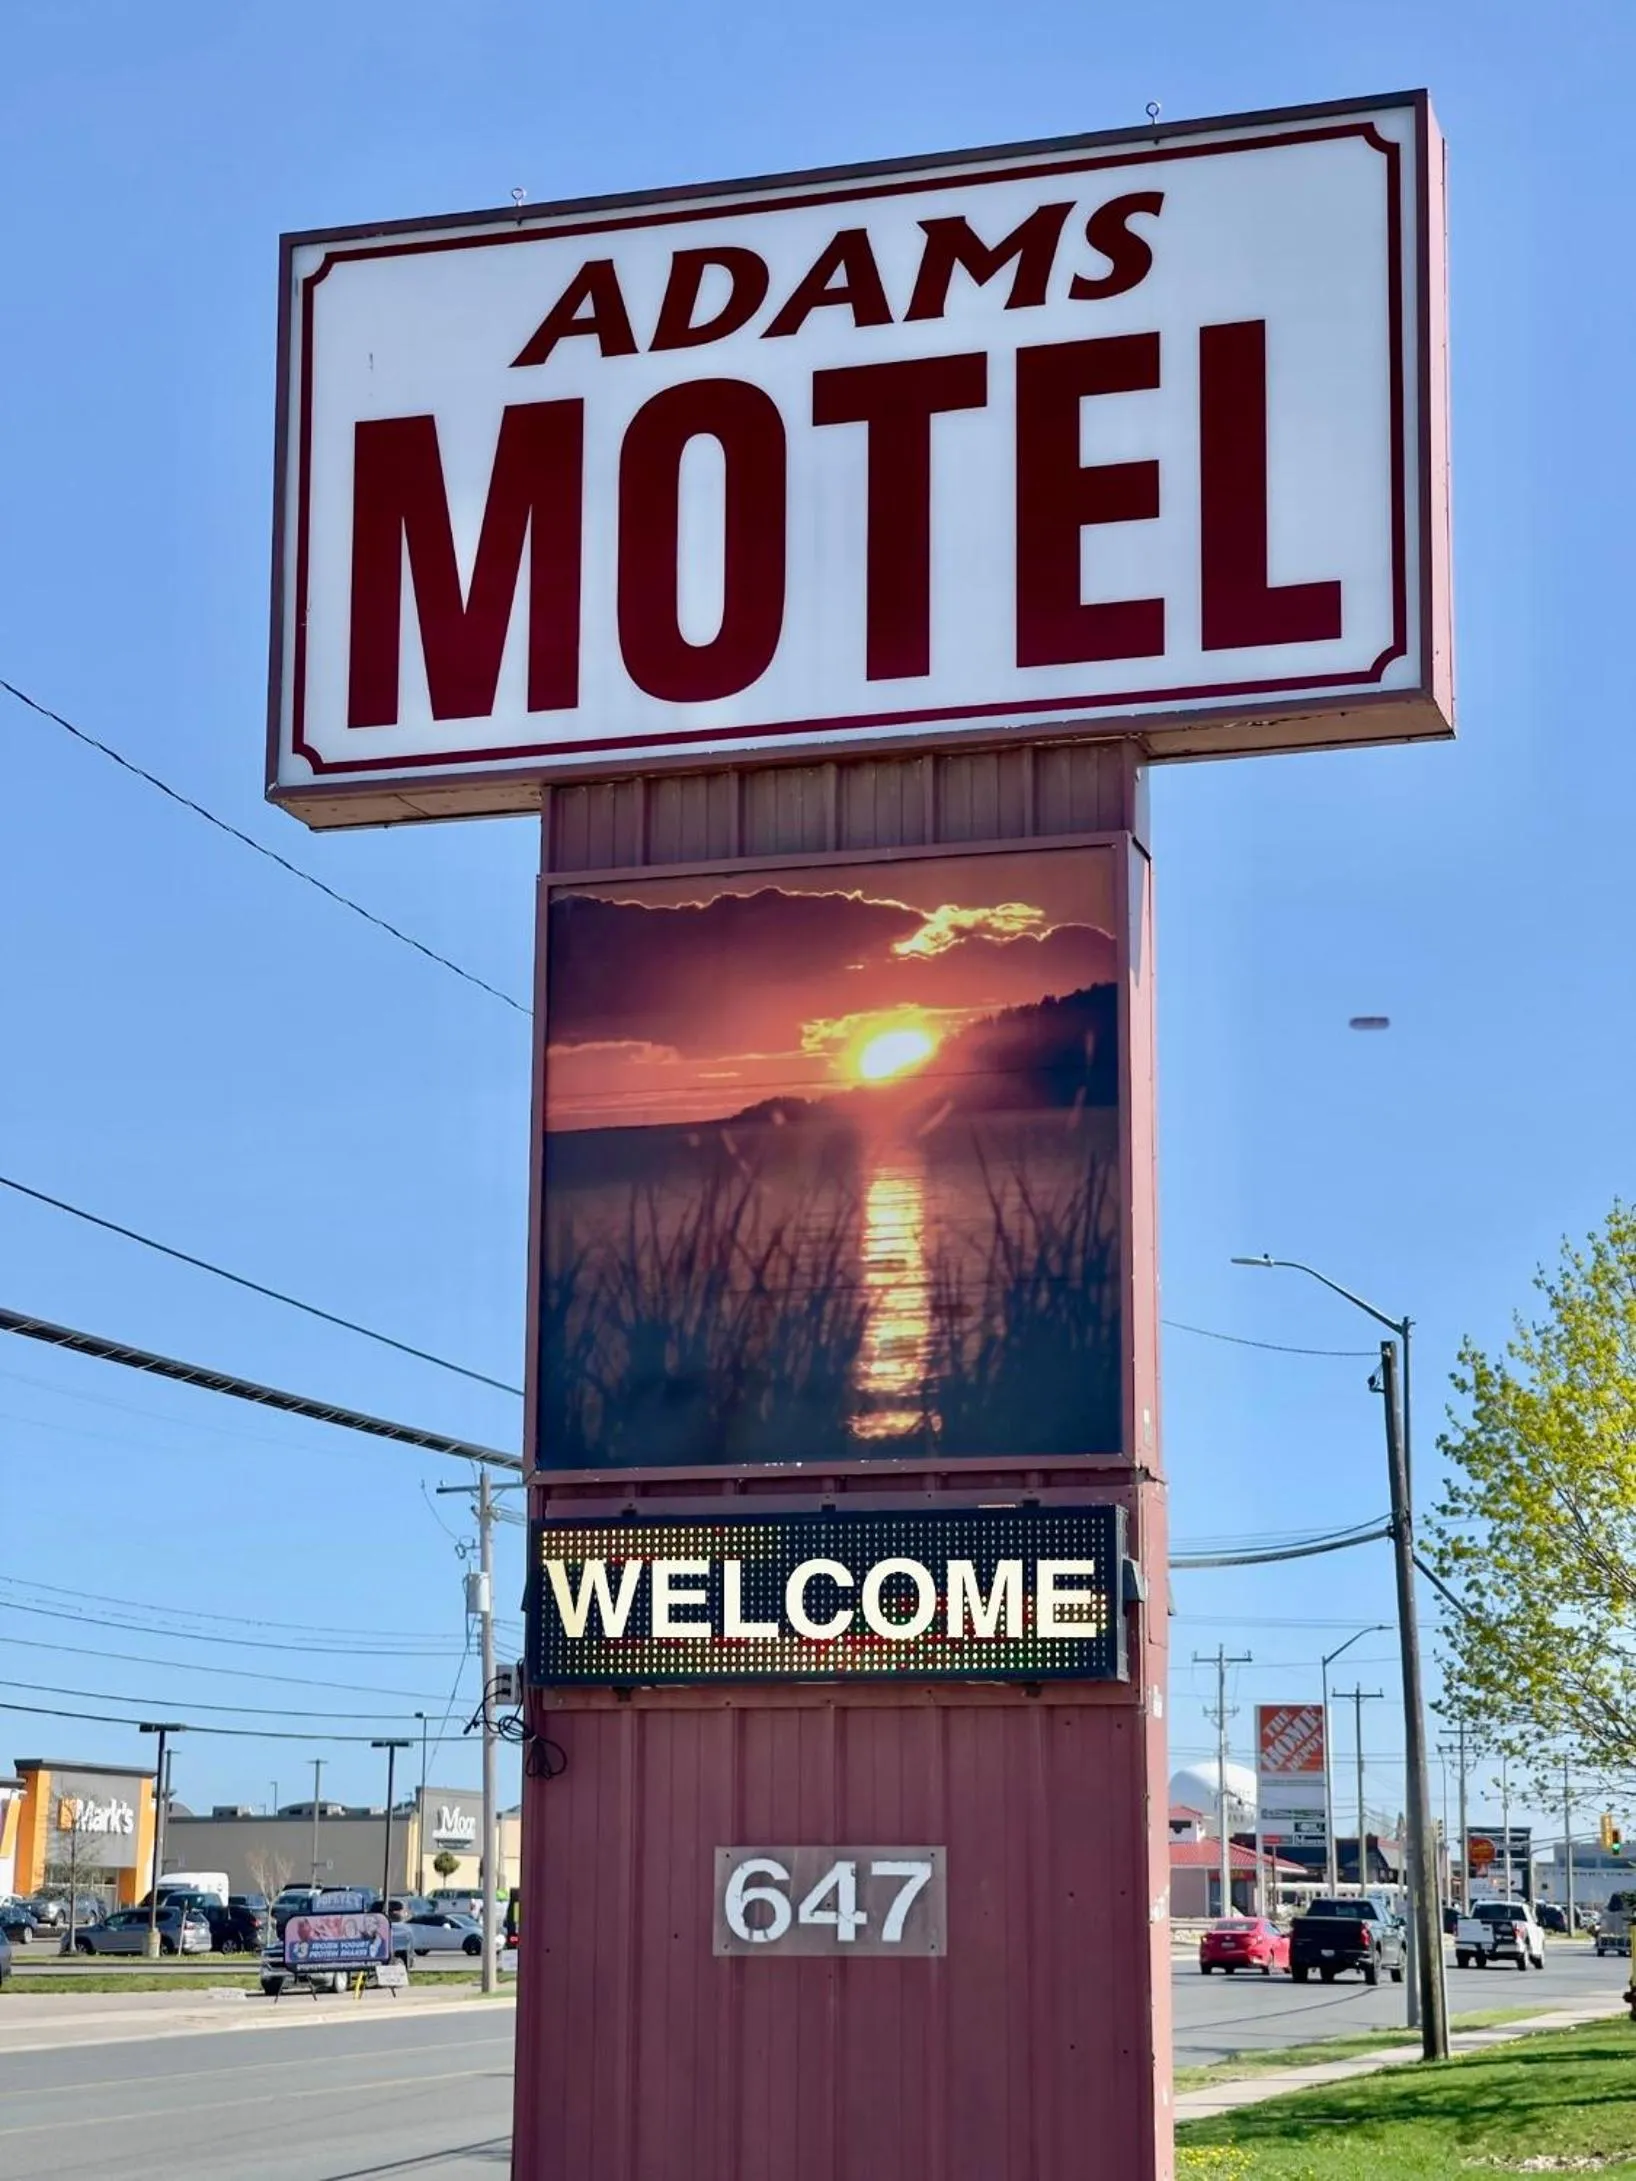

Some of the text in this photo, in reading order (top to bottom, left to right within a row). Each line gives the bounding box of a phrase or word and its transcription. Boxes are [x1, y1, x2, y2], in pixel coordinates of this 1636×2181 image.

[508, 190, 1165, 369] ADAMS
[347, 318, 1342, 729] MOTEL
[541, 1556, 1098, 1641] WELCOME
[1261, 1705, 1322, 1771] HOME
[75, 1798, 134, 1834] Mark's
[725, 1858, 932, 1943] 647
